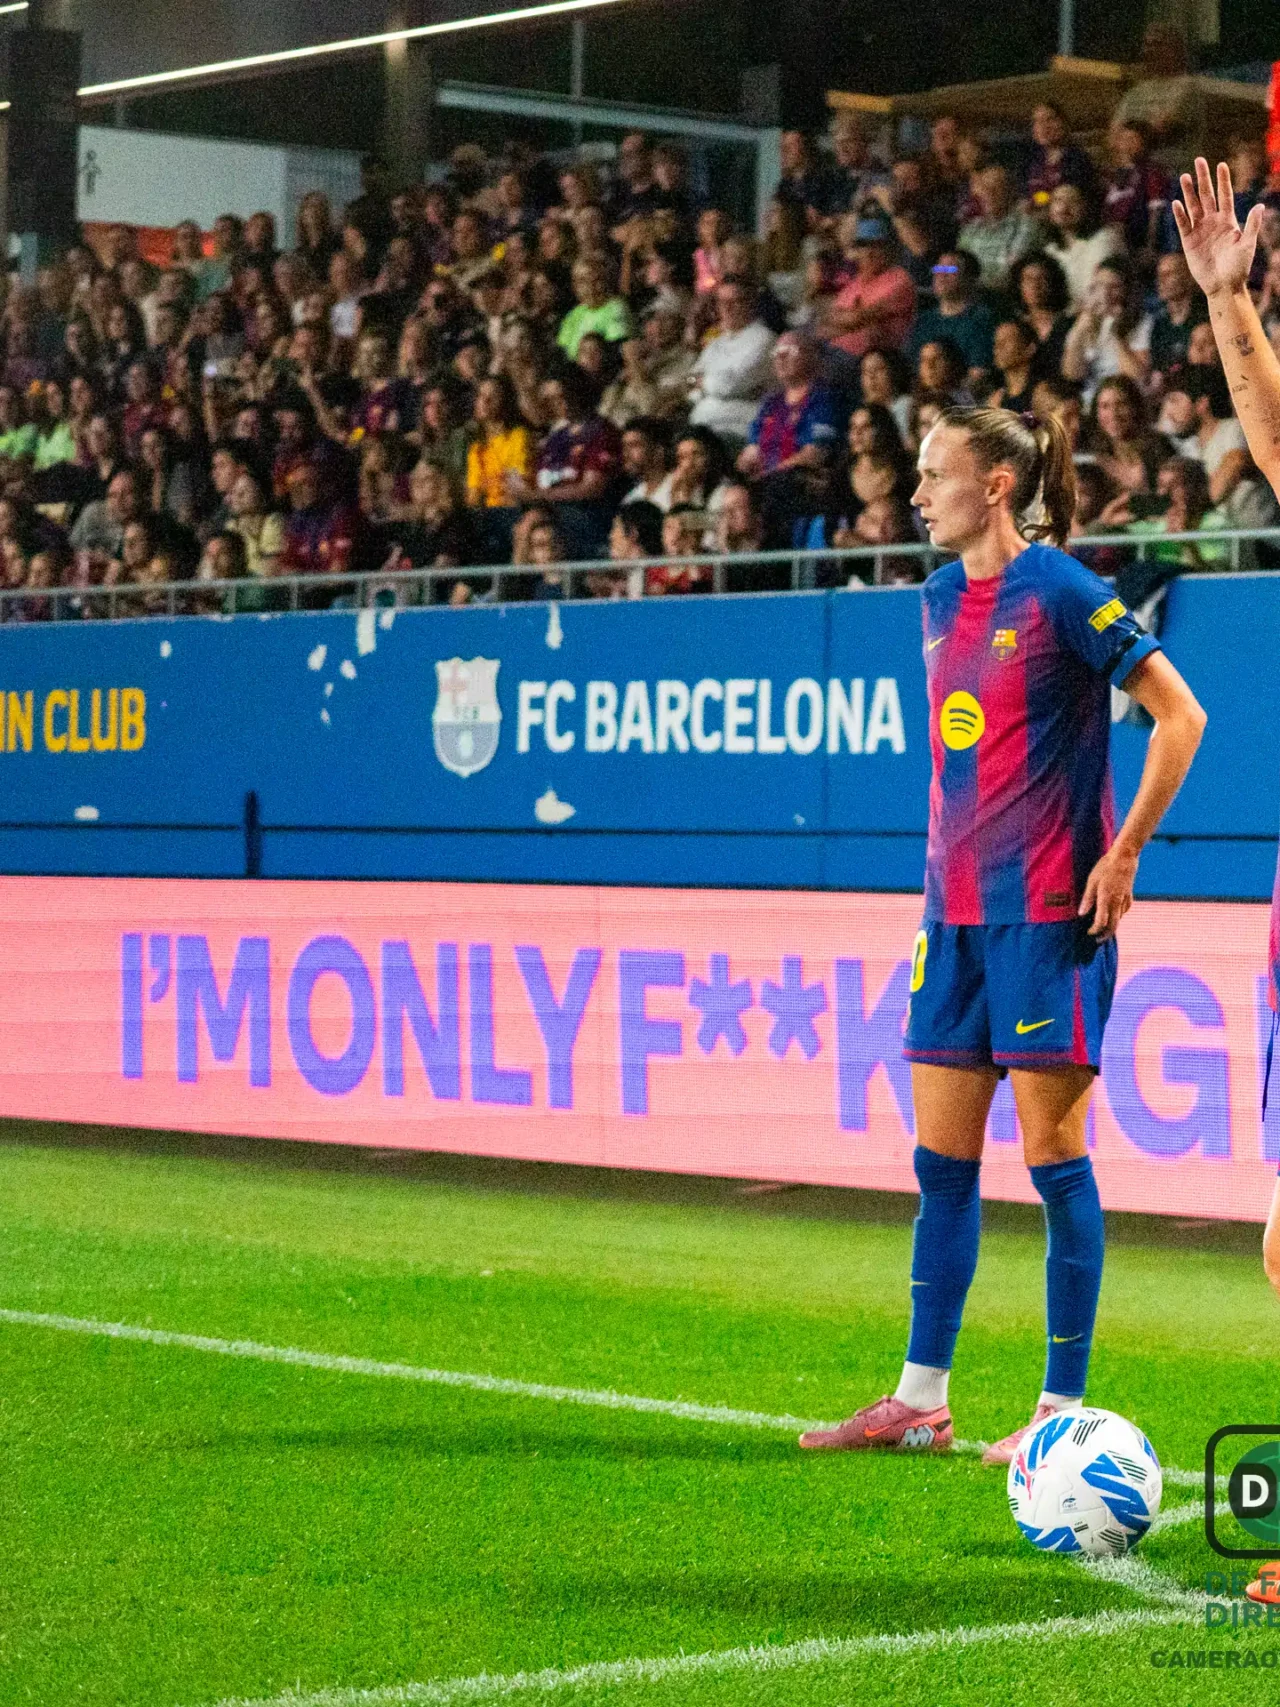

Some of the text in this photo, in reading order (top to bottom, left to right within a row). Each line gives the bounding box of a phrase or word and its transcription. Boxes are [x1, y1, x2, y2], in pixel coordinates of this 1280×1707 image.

[0, 688, 146, 753] N CLUB
[516, 677, 906, 755] FC BARCELONA
[287, 935, 603, 1109] ONLY
